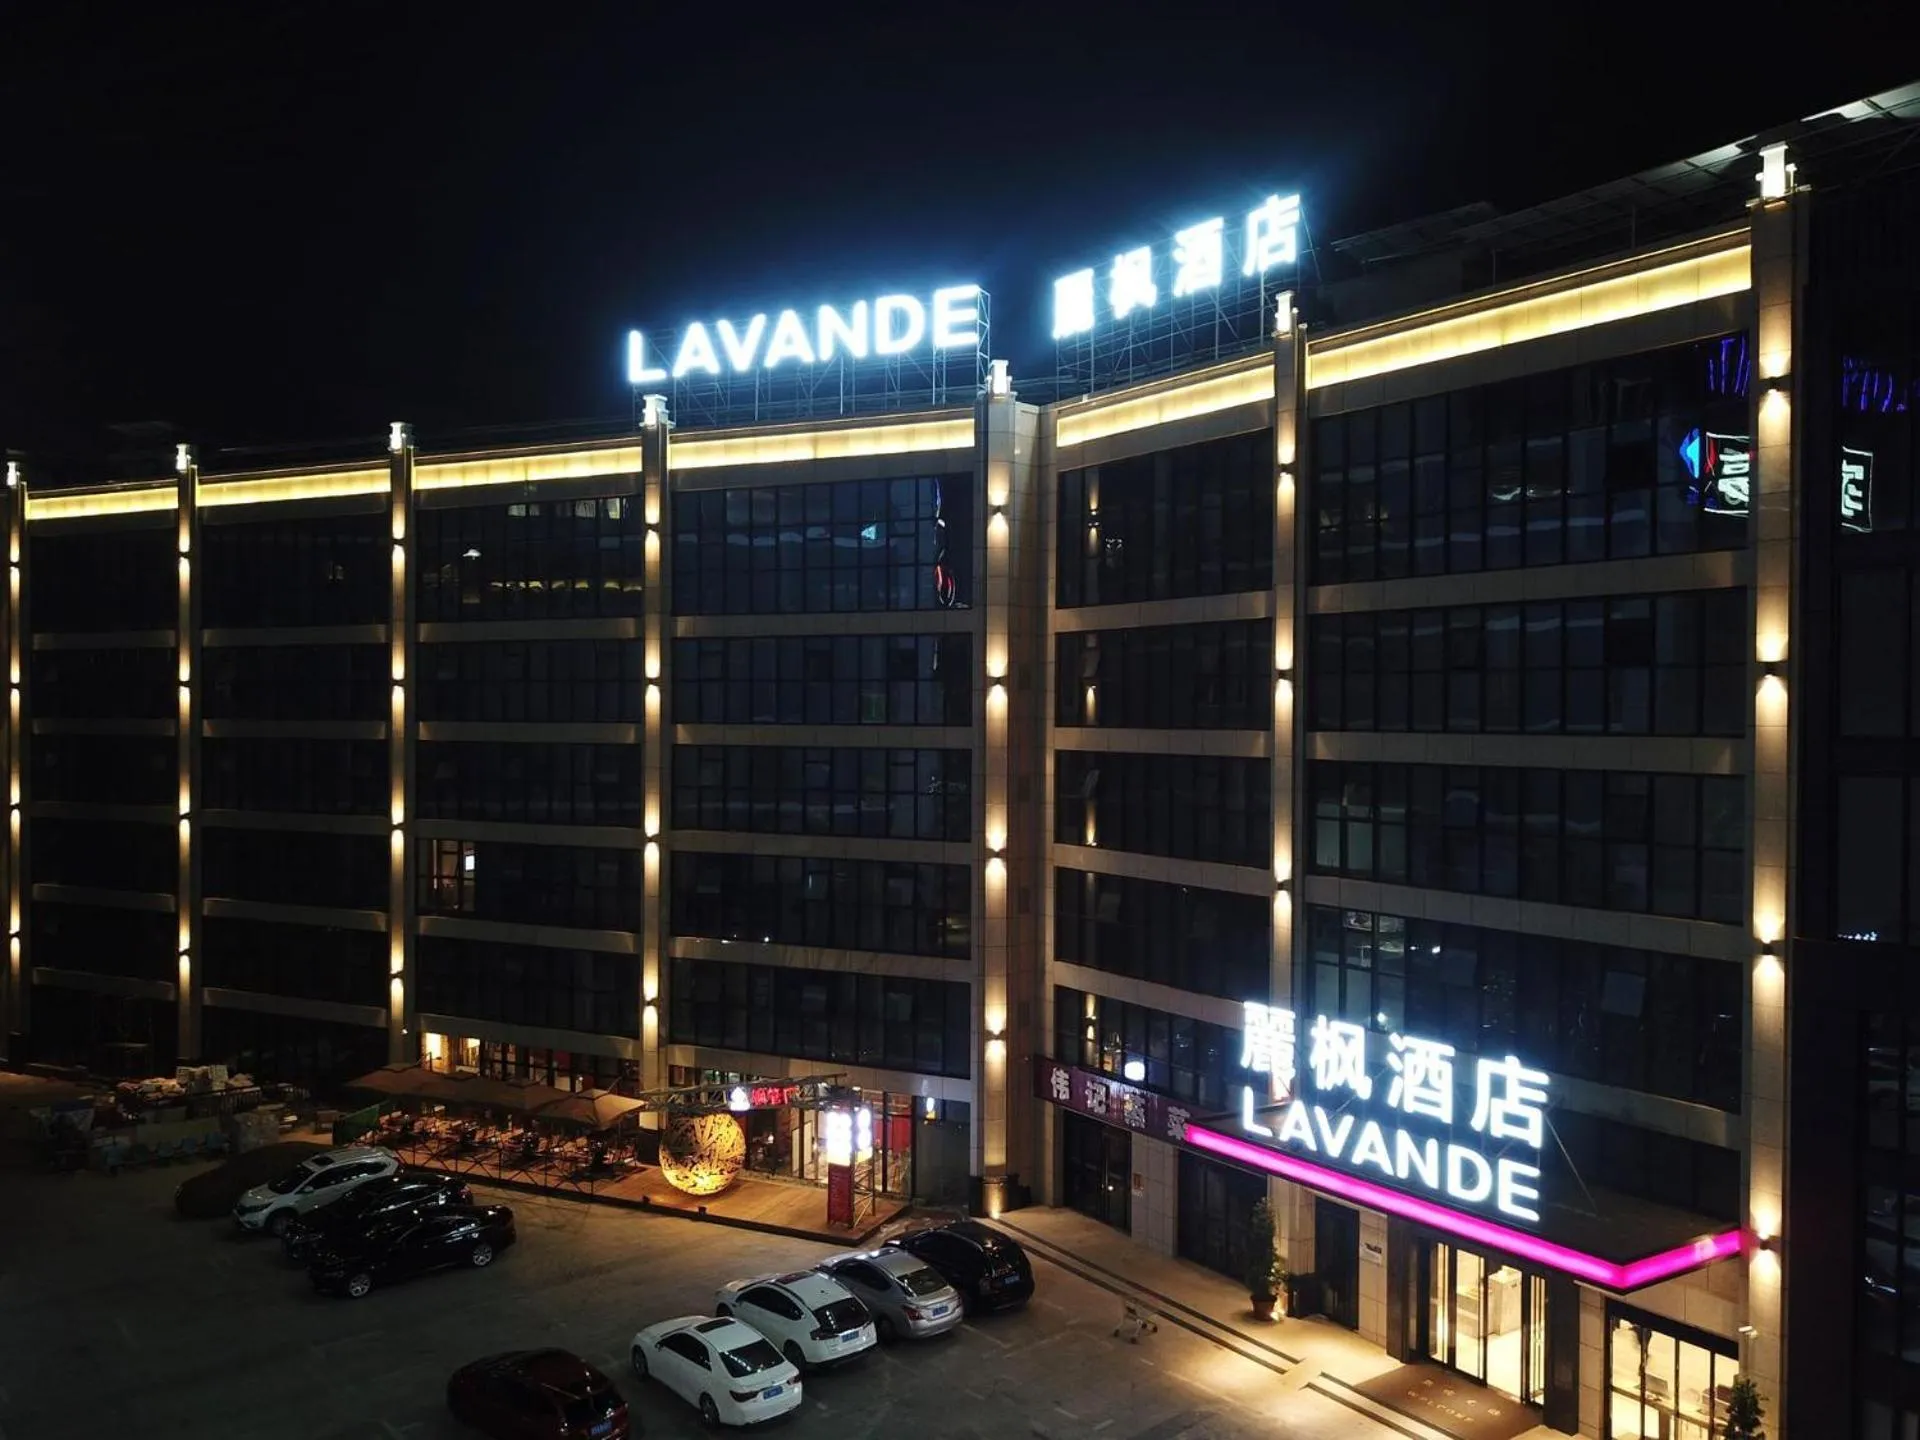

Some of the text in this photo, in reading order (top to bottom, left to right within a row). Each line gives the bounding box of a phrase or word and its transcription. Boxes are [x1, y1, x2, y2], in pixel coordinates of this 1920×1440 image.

[628, 284, 982, 384] LAVANDE
[1052, 194, 1300, 340] 枫酒店
[1241, 1001, 1549, 1148] 麗枫酒店
[1242, 1086, 1540, 1221] LAVANDE
